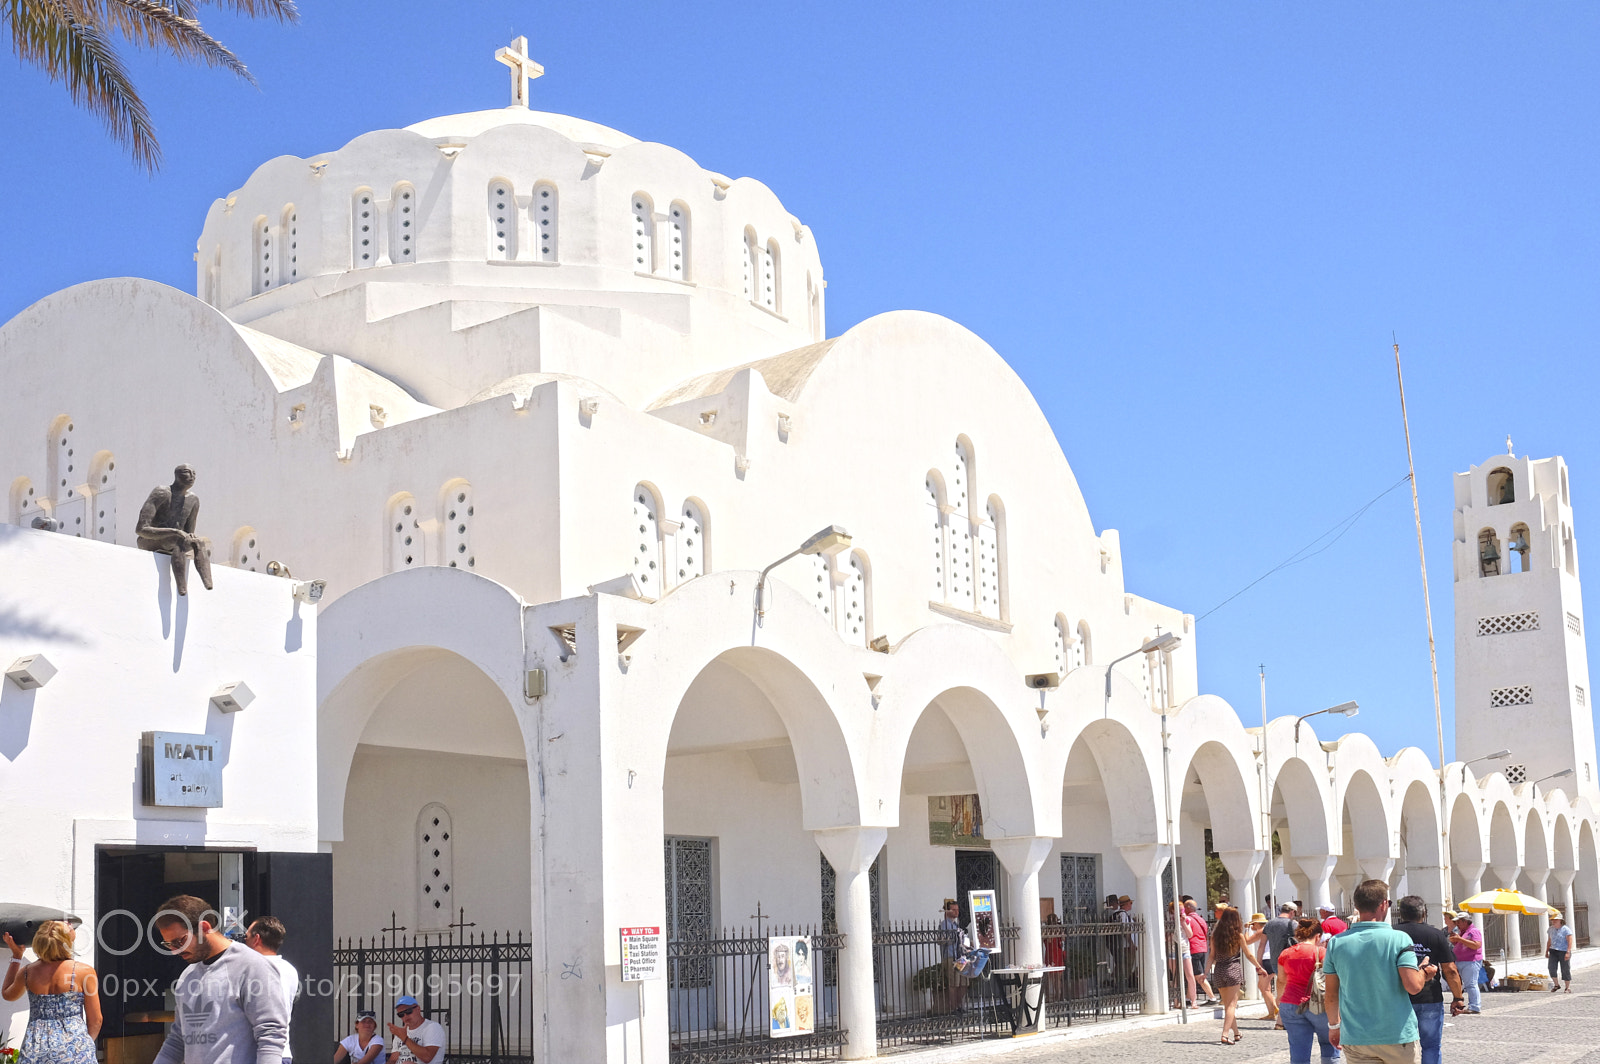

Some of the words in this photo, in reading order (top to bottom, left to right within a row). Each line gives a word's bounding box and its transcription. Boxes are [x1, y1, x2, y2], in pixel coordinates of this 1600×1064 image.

[164, 742, 214, 762] MATI
[170, 773, 183, 781] art
[181, 783, 208, 796] gallery
